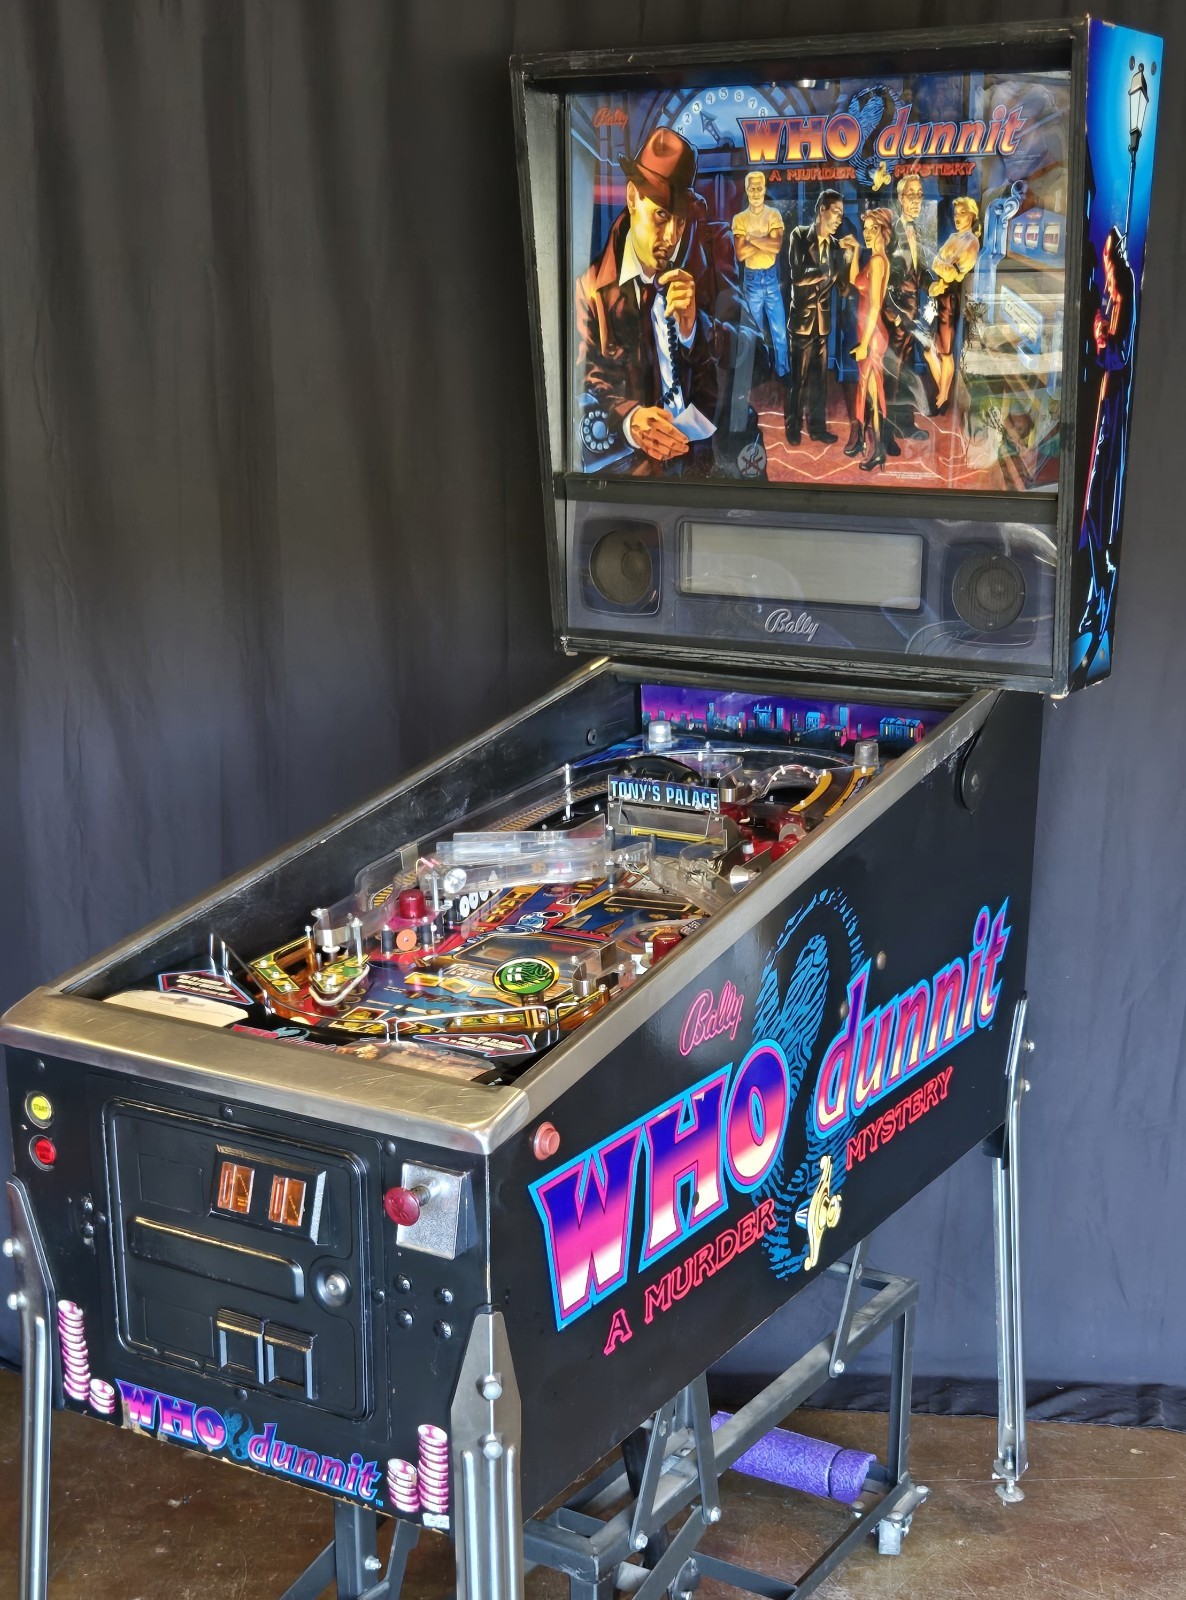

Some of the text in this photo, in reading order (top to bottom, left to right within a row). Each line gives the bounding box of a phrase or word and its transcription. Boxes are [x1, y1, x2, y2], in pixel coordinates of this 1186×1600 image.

[693, 102, 701, 112] 3
[707, 93, 713, 104] 4
[720, 87, 728, 99] 5
[736, 103, 1027, 164] WHO dunnit
[769, 162, 976, 182] A MURDER MYSTERY
[764, 608, 819, 642] Bally
[610, 780, 719, 811] TONY'S PALACE
[678, 981, 743, 1057] Bally
[528, 898, 1013, 1332] WHO dunnit
[604, 1066, 954, 1355] A MURDER MYSTERY
[114, 1378, 230, 1450] WHO
[248, 1422, 384, 1501] dunnit
